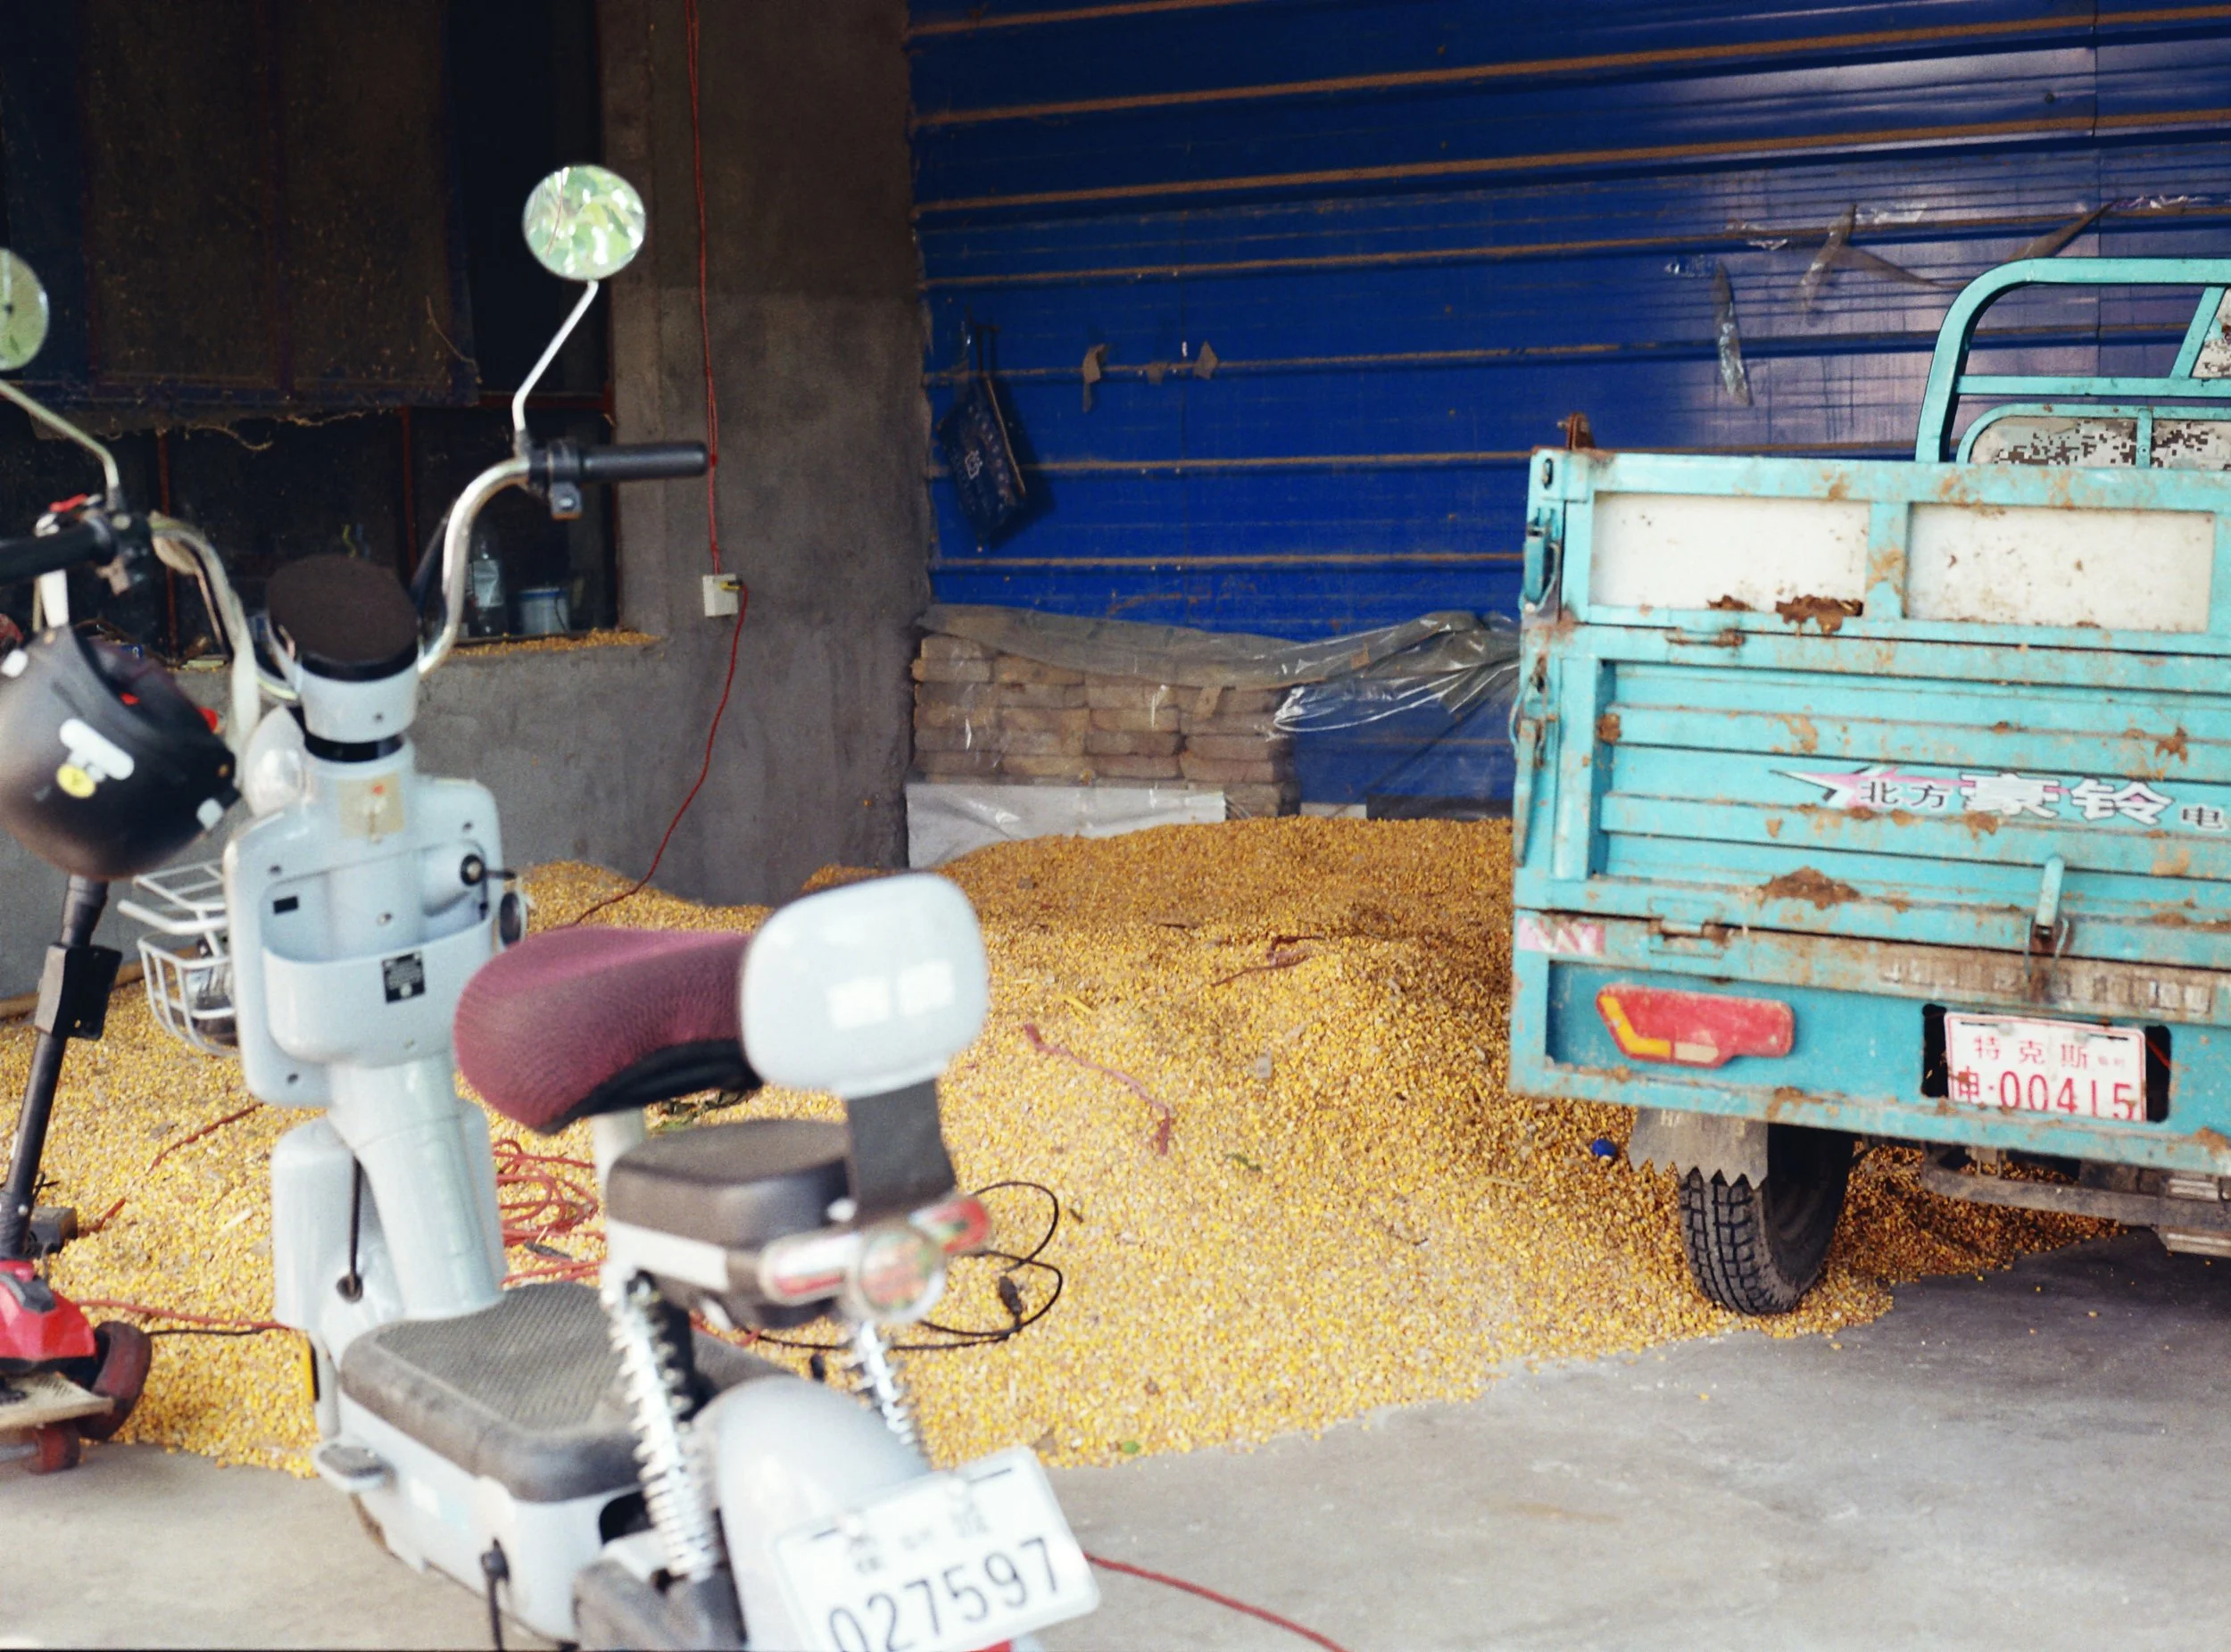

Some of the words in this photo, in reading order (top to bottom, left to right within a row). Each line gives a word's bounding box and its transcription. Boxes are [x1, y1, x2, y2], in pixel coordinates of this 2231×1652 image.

[1974, 1035, 2088, 1069] 特克斯
[829, 1536, 1058, 1651] 027597
